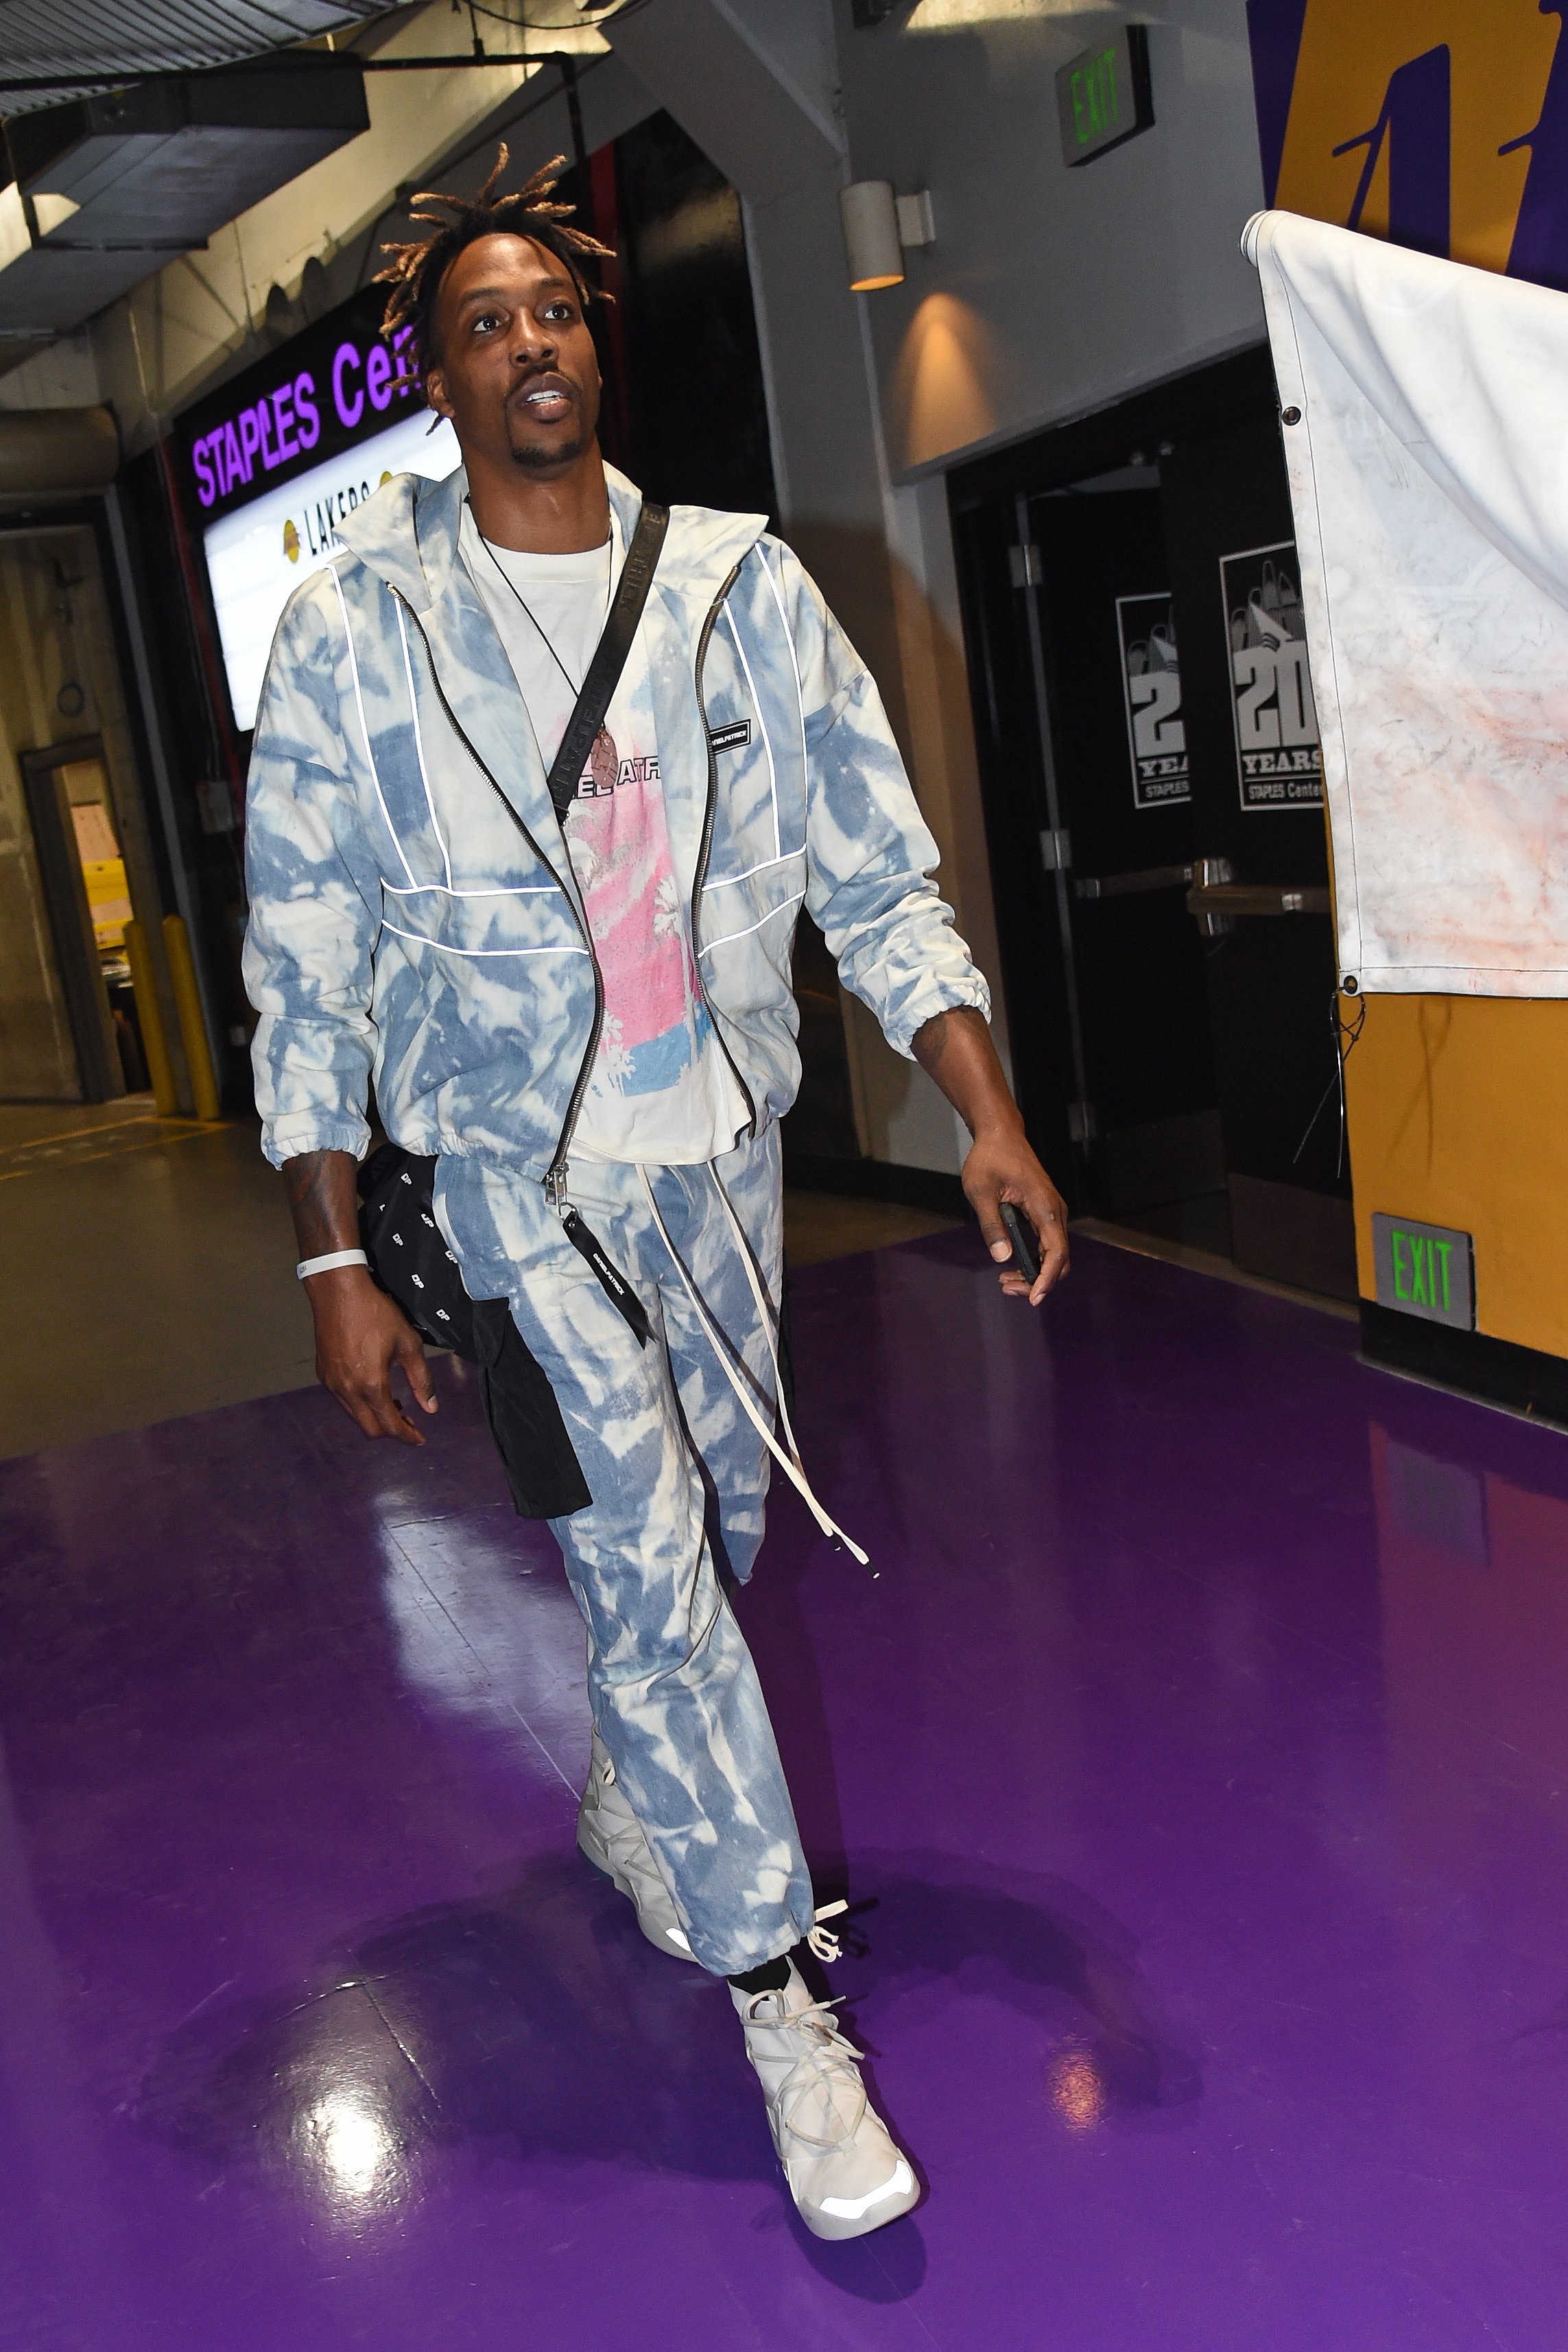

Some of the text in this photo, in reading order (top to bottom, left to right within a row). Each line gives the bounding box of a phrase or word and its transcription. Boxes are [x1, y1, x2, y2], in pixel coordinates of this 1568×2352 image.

[1070, 47, 1119, 145] EXIT
[193, 371, 320, 508] STAPLES
[1233, 641, 1321, 751] 20
[1242, 750, 1321, 775] YEARS
[1145, 781, 1190, 798] STAPLES
[1248, 783, 1285, 800] STAPLES
[401, 1172, 412, 1185] DP
[392, 1233, 404, 1246] DP
[445, 1250, 458, 1264] DP
[1391, 1229, 1453, 1311] EXIT
[411, 1274, 425, 1289] DP
[436, 1309, 451, 1321] DP
